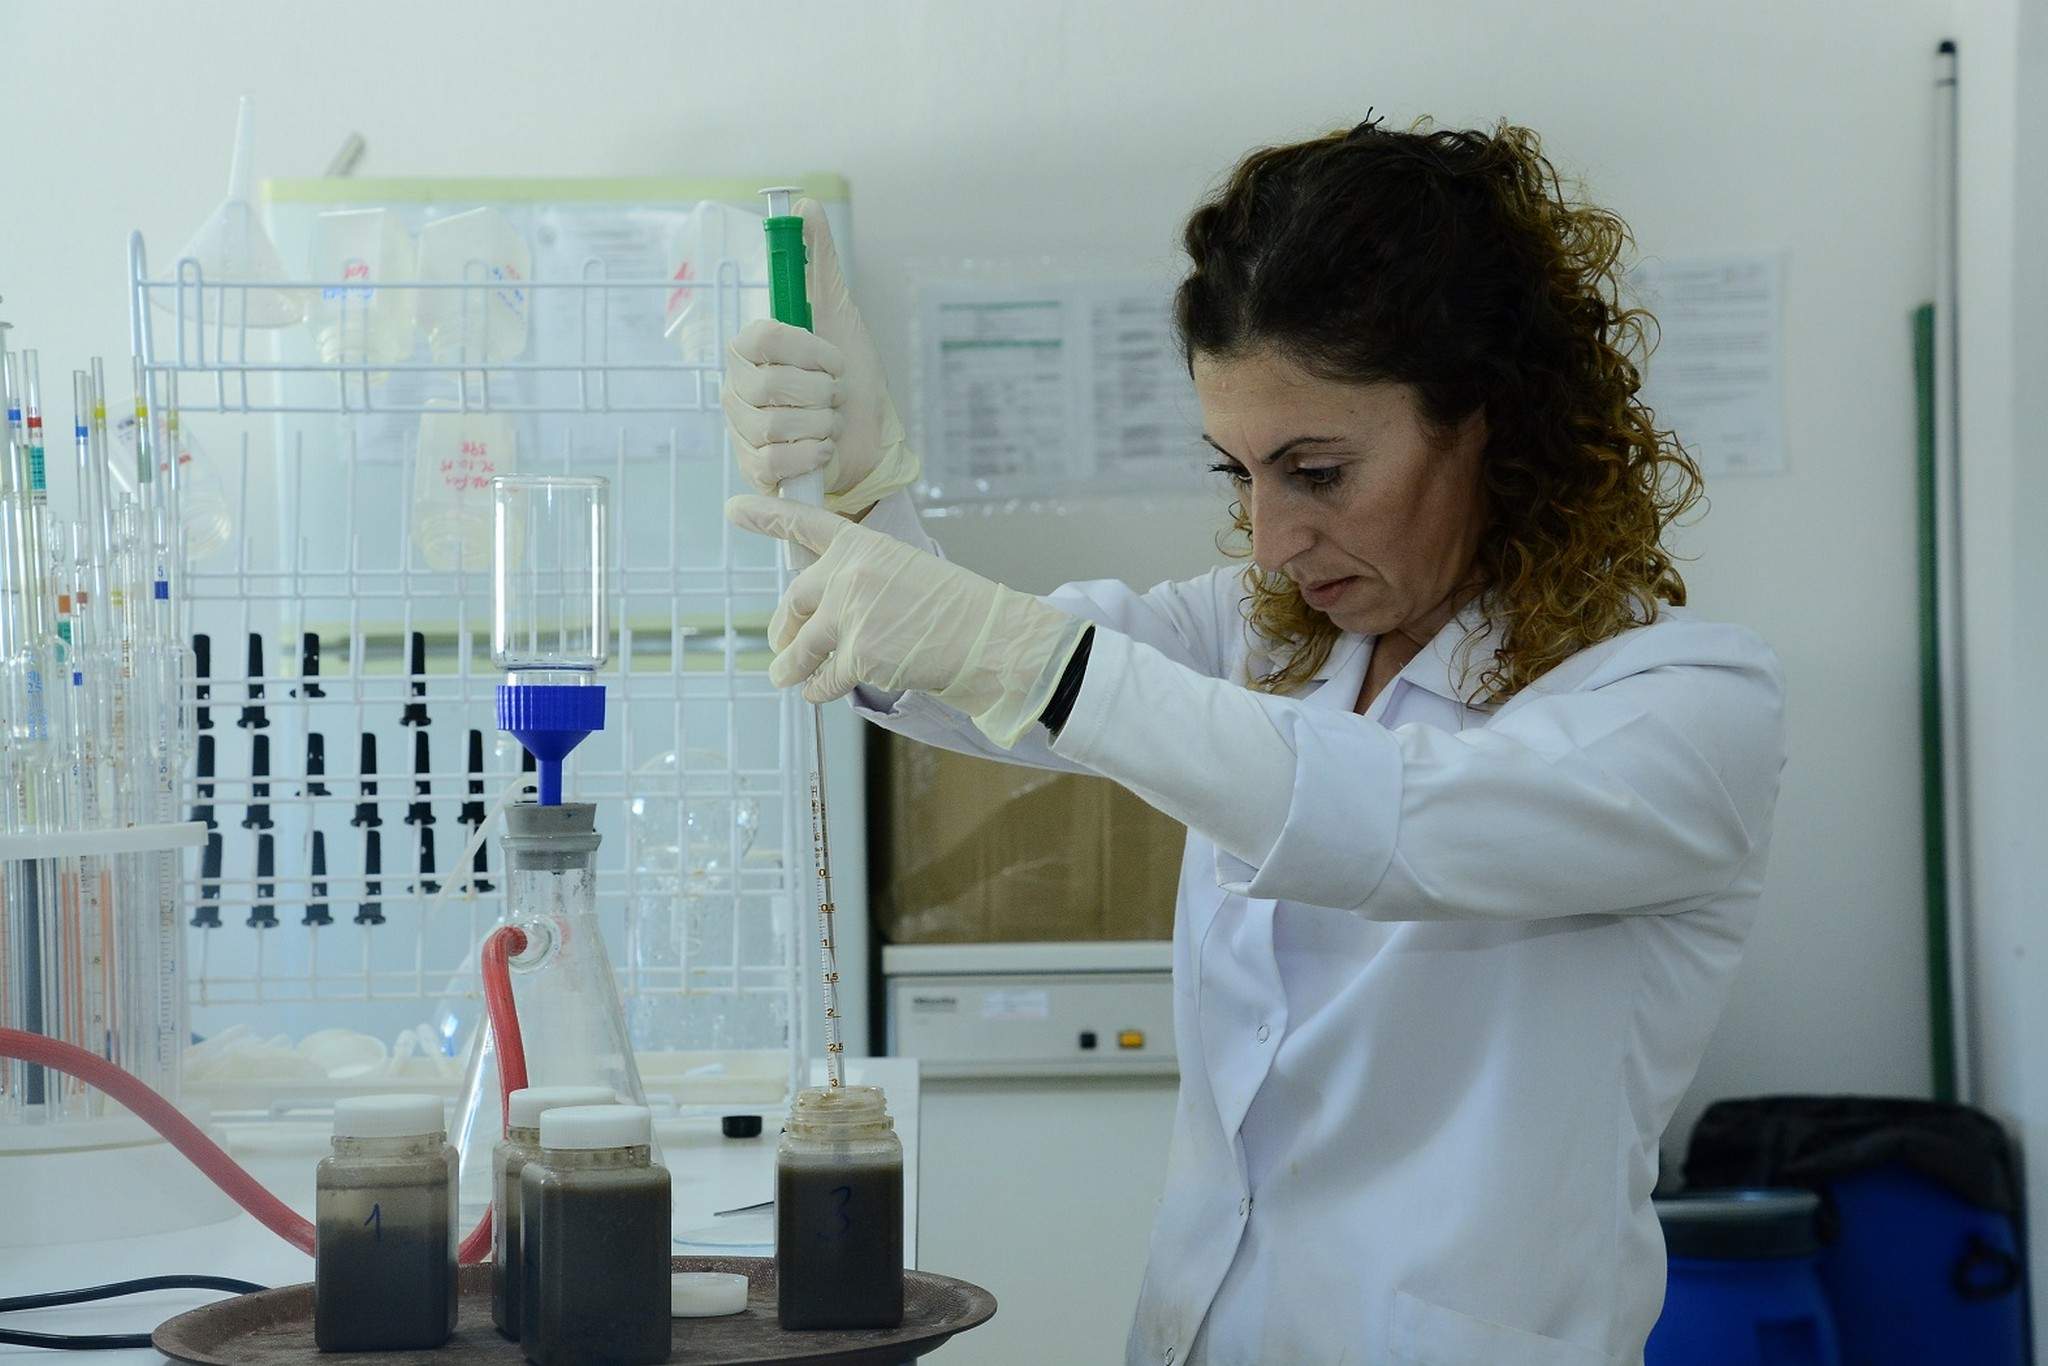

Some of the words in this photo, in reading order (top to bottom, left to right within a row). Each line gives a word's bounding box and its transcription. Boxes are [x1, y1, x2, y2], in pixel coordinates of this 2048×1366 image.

[818, 868, 826, 878] 0
[822, 938, 828, 947] 1
[827, 1007, 834, 1017] 2
[830, 1078, 838, 1088] 3
[815, 1185, 852, 1241] 3
[363, 1202, 382, 1242] 1
